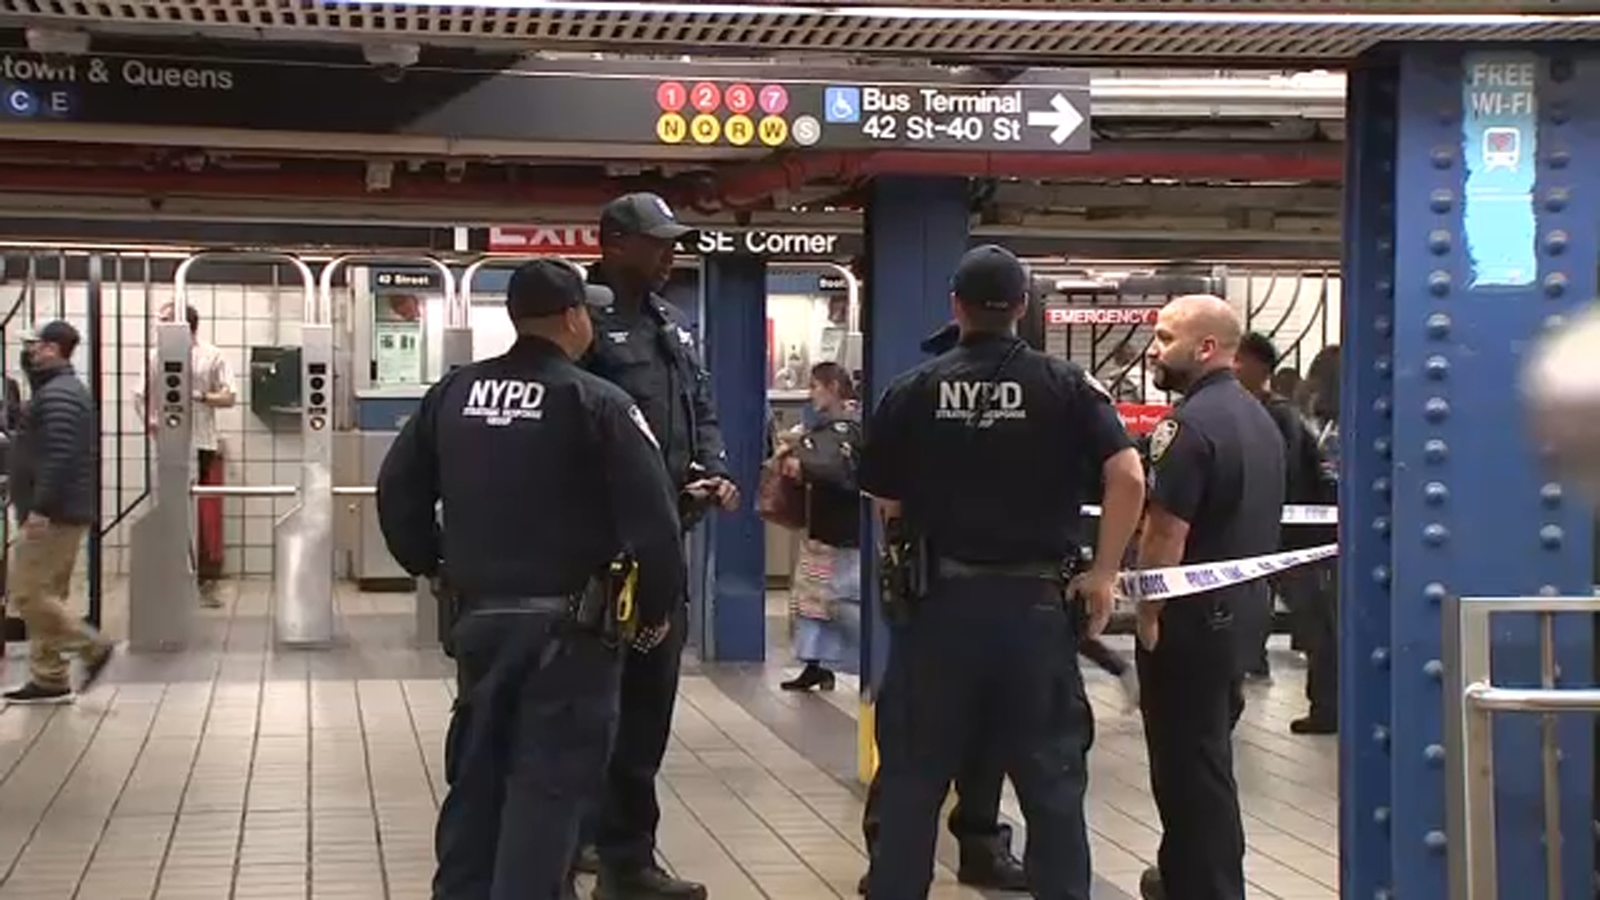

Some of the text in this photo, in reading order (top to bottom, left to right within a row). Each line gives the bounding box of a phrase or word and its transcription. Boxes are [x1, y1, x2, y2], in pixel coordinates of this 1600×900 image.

[87, 58, 109, 83] &
[122, 60, 234, 89] Queens
[1472, 63, 1534, 87] FREE
[10, 90, 69, 112] C E
[699, 88, 713, 107] 2
[733, 89, 747, 108] 3
[767, 91, 781, 110] 7
[862, 88, 1022, 113] Bus Terminal
[1471, 91, 1533, 115] WI-FI
[664, 120, 814, 139] N Q R W S
[862, 115, 1022, 141] 42 St-40 St
[697, 231, 735, 252] SE
[745, 231, 838, 253] Corner
[394, 274, 430, 286] Street
[1051, 308, 1152, 324] EMERGENCY
[468, 380, 545, 408] NYPD
[939, 381, 1023, 410] NYPD
